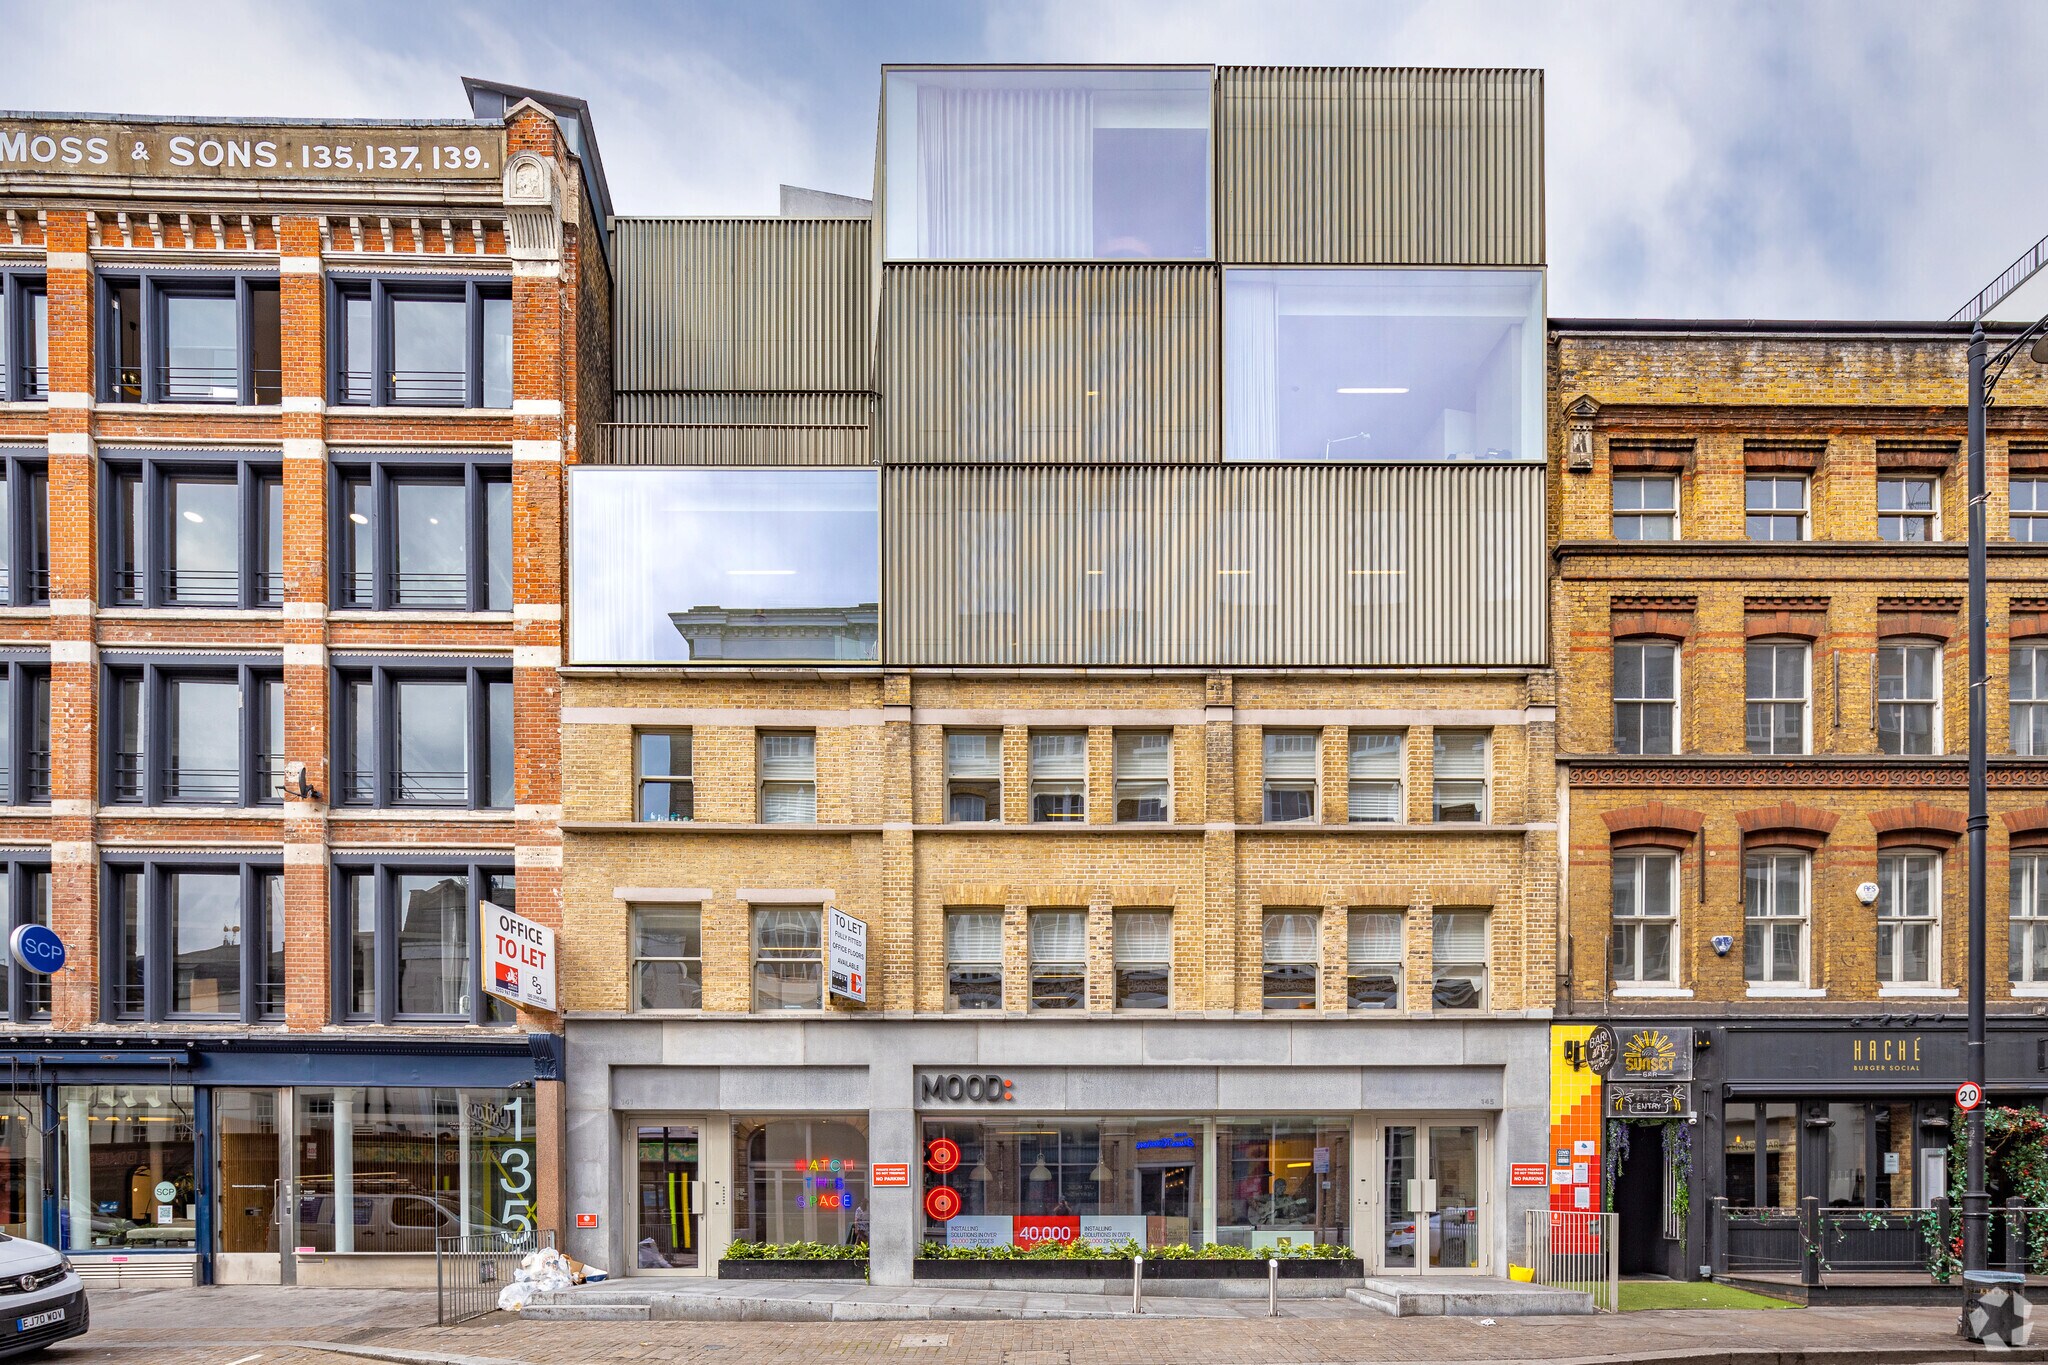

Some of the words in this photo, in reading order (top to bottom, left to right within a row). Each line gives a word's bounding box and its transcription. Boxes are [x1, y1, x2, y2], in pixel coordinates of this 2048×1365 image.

[0, 131, 109, 164] MOSS
[131, 141, 150, 161] &
[500, 915, 543, 946] OFFICE
[835, 914, 846, 929] TO
[848, 920, 862, 936] LET
[835, 930, 847, 941] FULLY
[847, 936, 862, 947] FITTED
[25, 938, 62, 960] SCP
[496, 934, 517, 959] TO
[521, 944, 547, 970] LET
[832, 942, 847, 953] OFFICE
[847, 948, 864, 960] FLOORS
[837, 958, 859, 972] AVAILABLE
[1589, 1032, 1608, 1049] BAR
[1854, 1037, 1921, 1061] HACHÉ
[1636, 1092, 1661, 1101] FREE
[1960, 1090, 1977, 1102] 20
[795, 1159, 854, 1172] WATCH
[156, 1188, 175, 1196] SCP
[805, 1177, 844, 1190] THIS
[796, 1194, 852, 1208] SPACE
[1020, 1226, 1071, 1241] 40,000
[23, 1315, 45, 1328] EJ70
[47, 1310, 63, 1321] WOV
